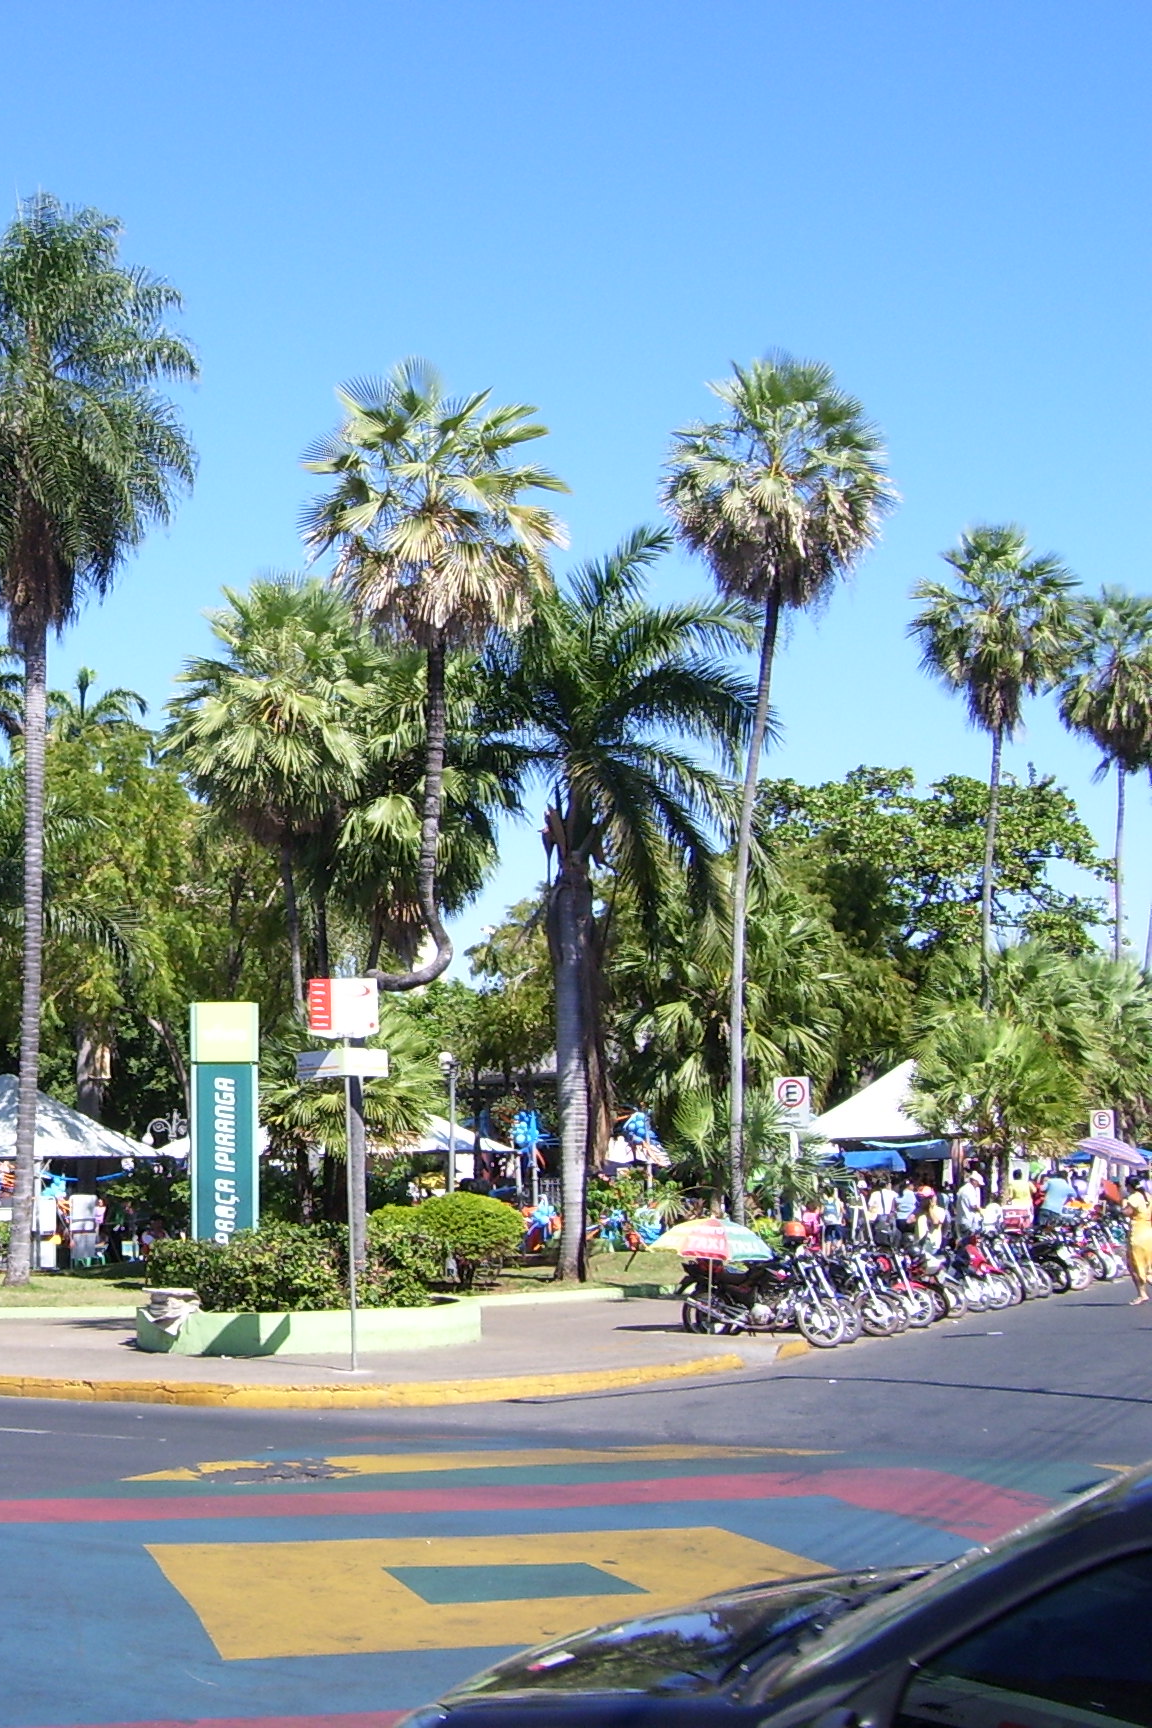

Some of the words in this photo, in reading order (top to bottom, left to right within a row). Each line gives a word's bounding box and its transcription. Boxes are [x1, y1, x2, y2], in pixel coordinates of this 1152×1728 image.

[785, 1085, 797, 1102] E
[214, 1077, 236, 1173] IPIRANGA
[1098, 1114, 1107, 1126] E
[214, 1178, 240, 1245] PRAÇA
[687, 1237, 725, 1251] TAXI
